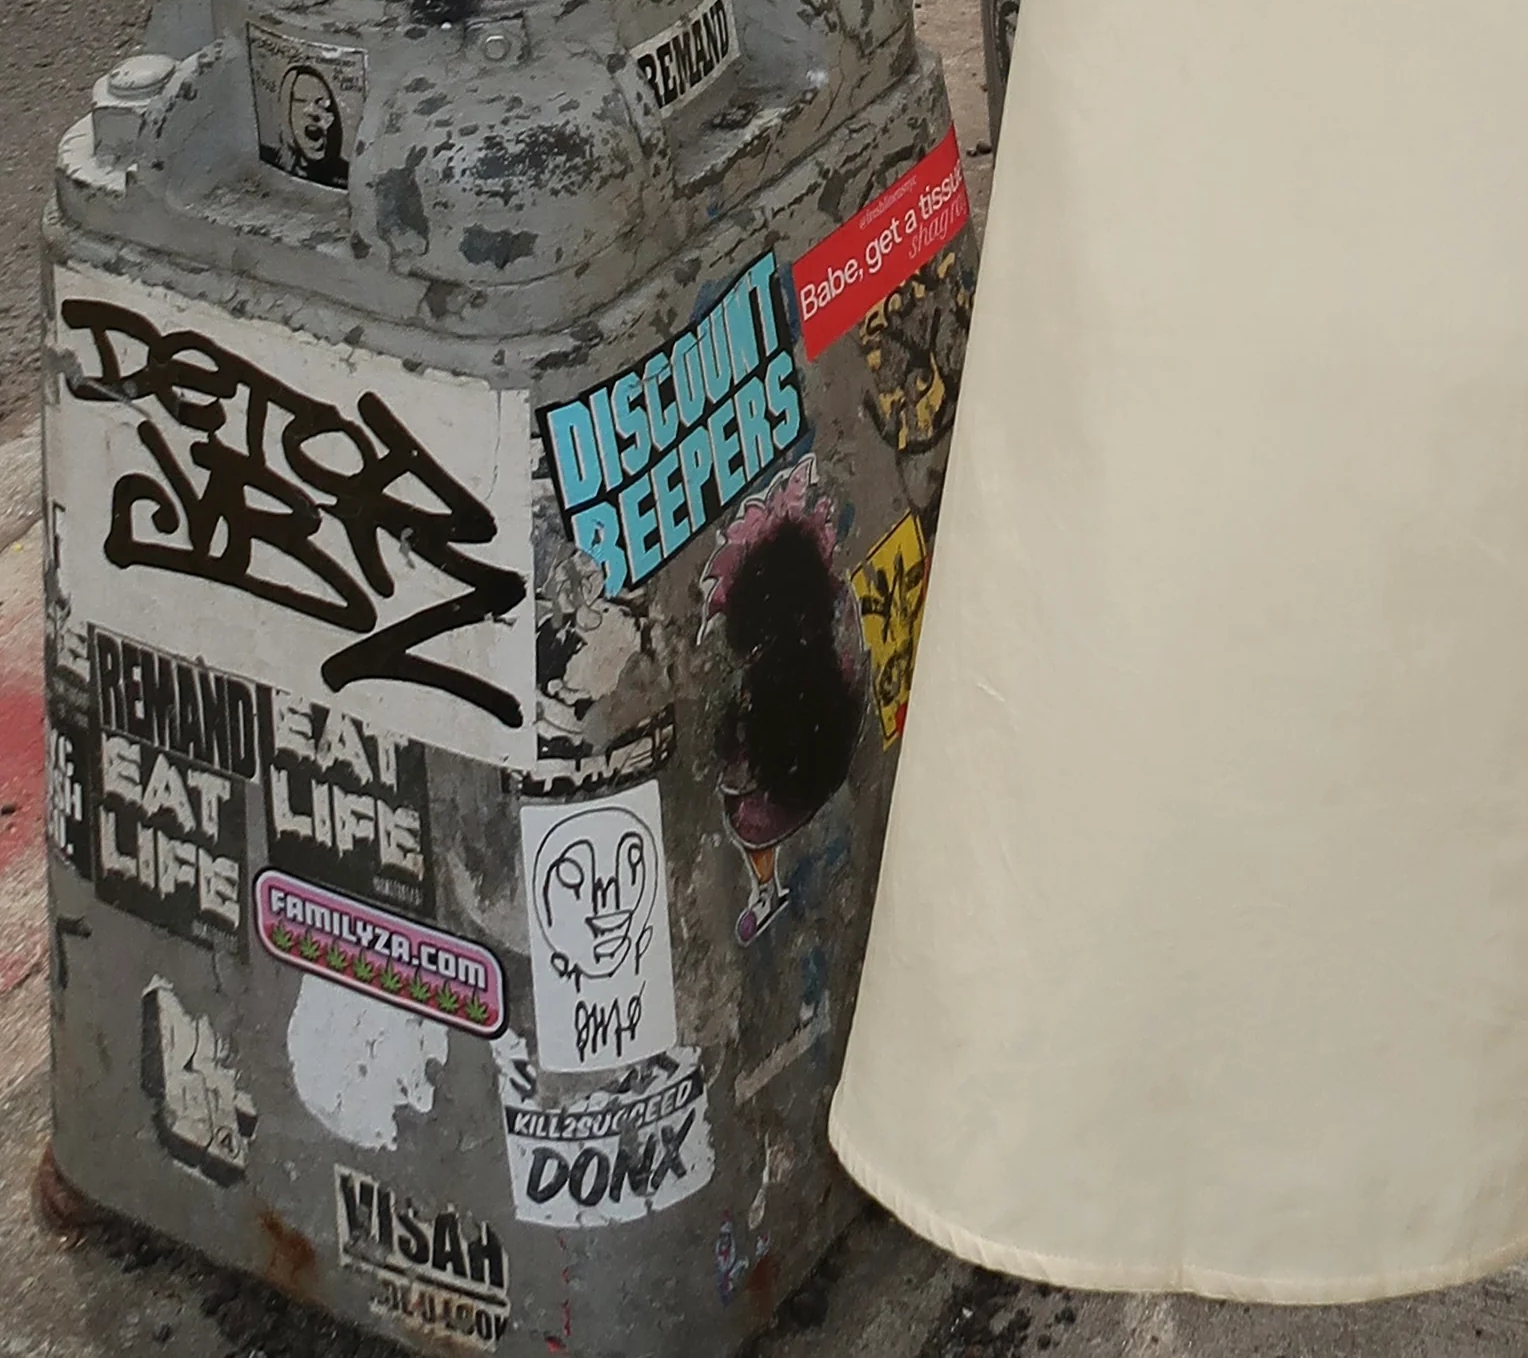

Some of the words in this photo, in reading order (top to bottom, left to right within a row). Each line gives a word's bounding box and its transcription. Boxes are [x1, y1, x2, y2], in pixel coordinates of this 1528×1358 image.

[799, 247, 865, 322] Babe,
[864, 216, 902, 274] get
[904, 208, 918, 234] a
[547, 251, 777, 510] DISCOUNT
[570, 350, 801, 598] BEEPERS
[97, 629, 259, 782] REMAND
[102, 733, 232, 846] EAT
[271, 765, 425, 882] LIFE
[101, 804, 241, 930] LIFE
[268, 886, 488, 990] FAMILYZA.COM
[526, 1106, 697, 1207] DONX
